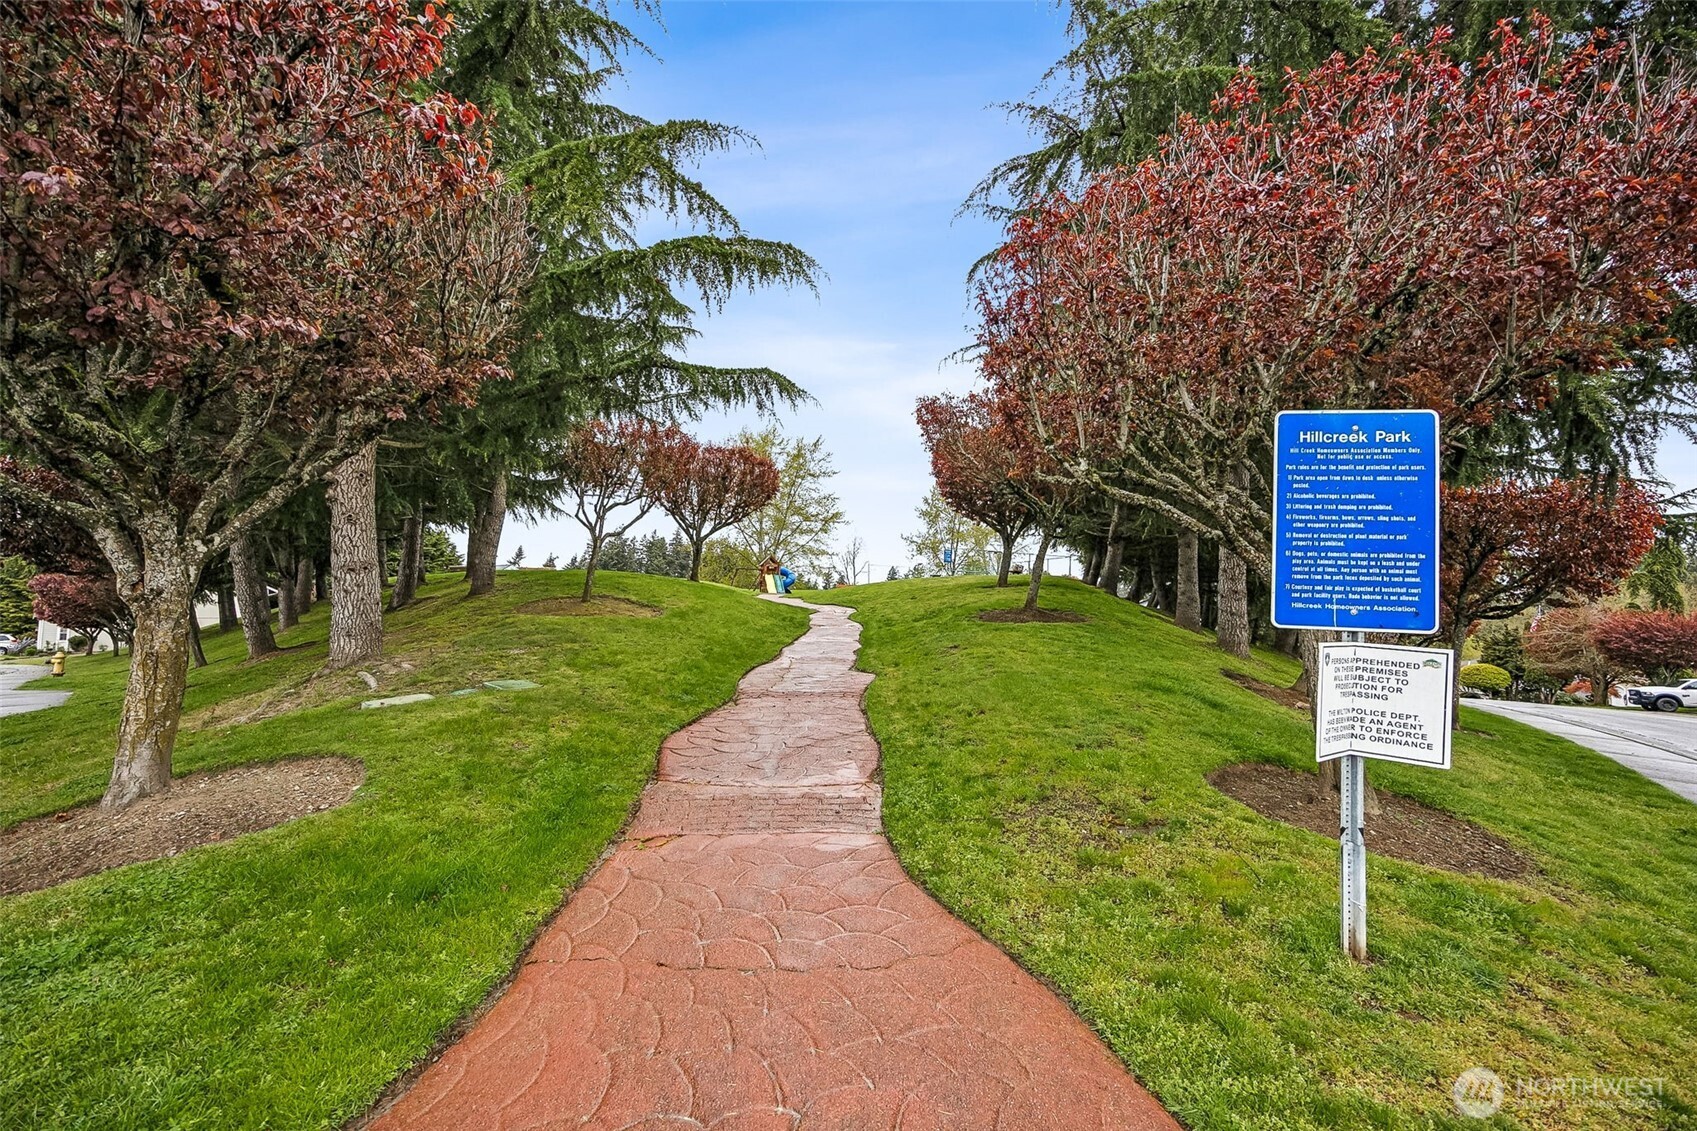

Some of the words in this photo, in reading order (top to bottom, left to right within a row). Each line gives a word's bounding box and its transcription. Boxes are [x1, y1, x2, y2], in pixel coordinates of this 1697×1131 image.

[1298, 430, 1368, 443] Hillcreek
[1375, 430, 1411, 442] Park
[1324, 602, 1370, 610] Homeowners
[1350, 658, 1420, 670] APPREHENDED
[1355, 666, 1408, 677] PREMISES
[1350, 674, 1391, 684] SUBJECT
[1352, 708, 1386, 717] POLICE
[1391, 712, 1420, 722] DEPT.
[1387, 721, 1423, 730] AGENT
[1376, 728, 1428, 740] ENFORCE
[1369, 736, 1433, 750] ORDINANCE
